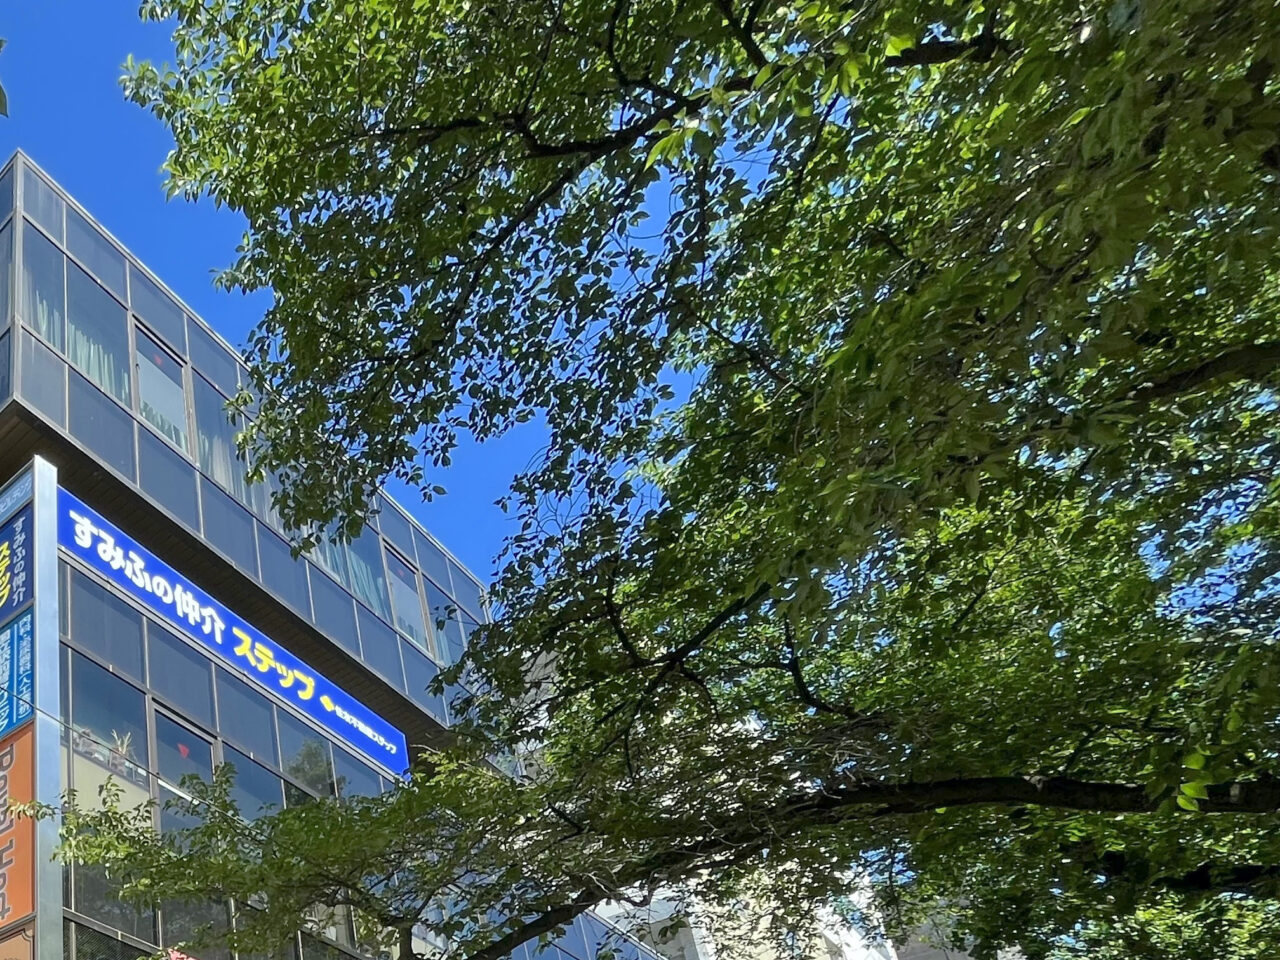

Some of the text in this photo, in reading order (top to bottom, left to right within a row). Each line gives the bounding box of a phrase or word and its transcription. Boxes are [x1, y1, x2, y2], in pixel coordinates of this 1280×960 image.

[12, 516, 26, 607] すみふの仲介
[69, 509, 226, 645] すみふの仲介
[232, 627, 315, 700] ステップ
